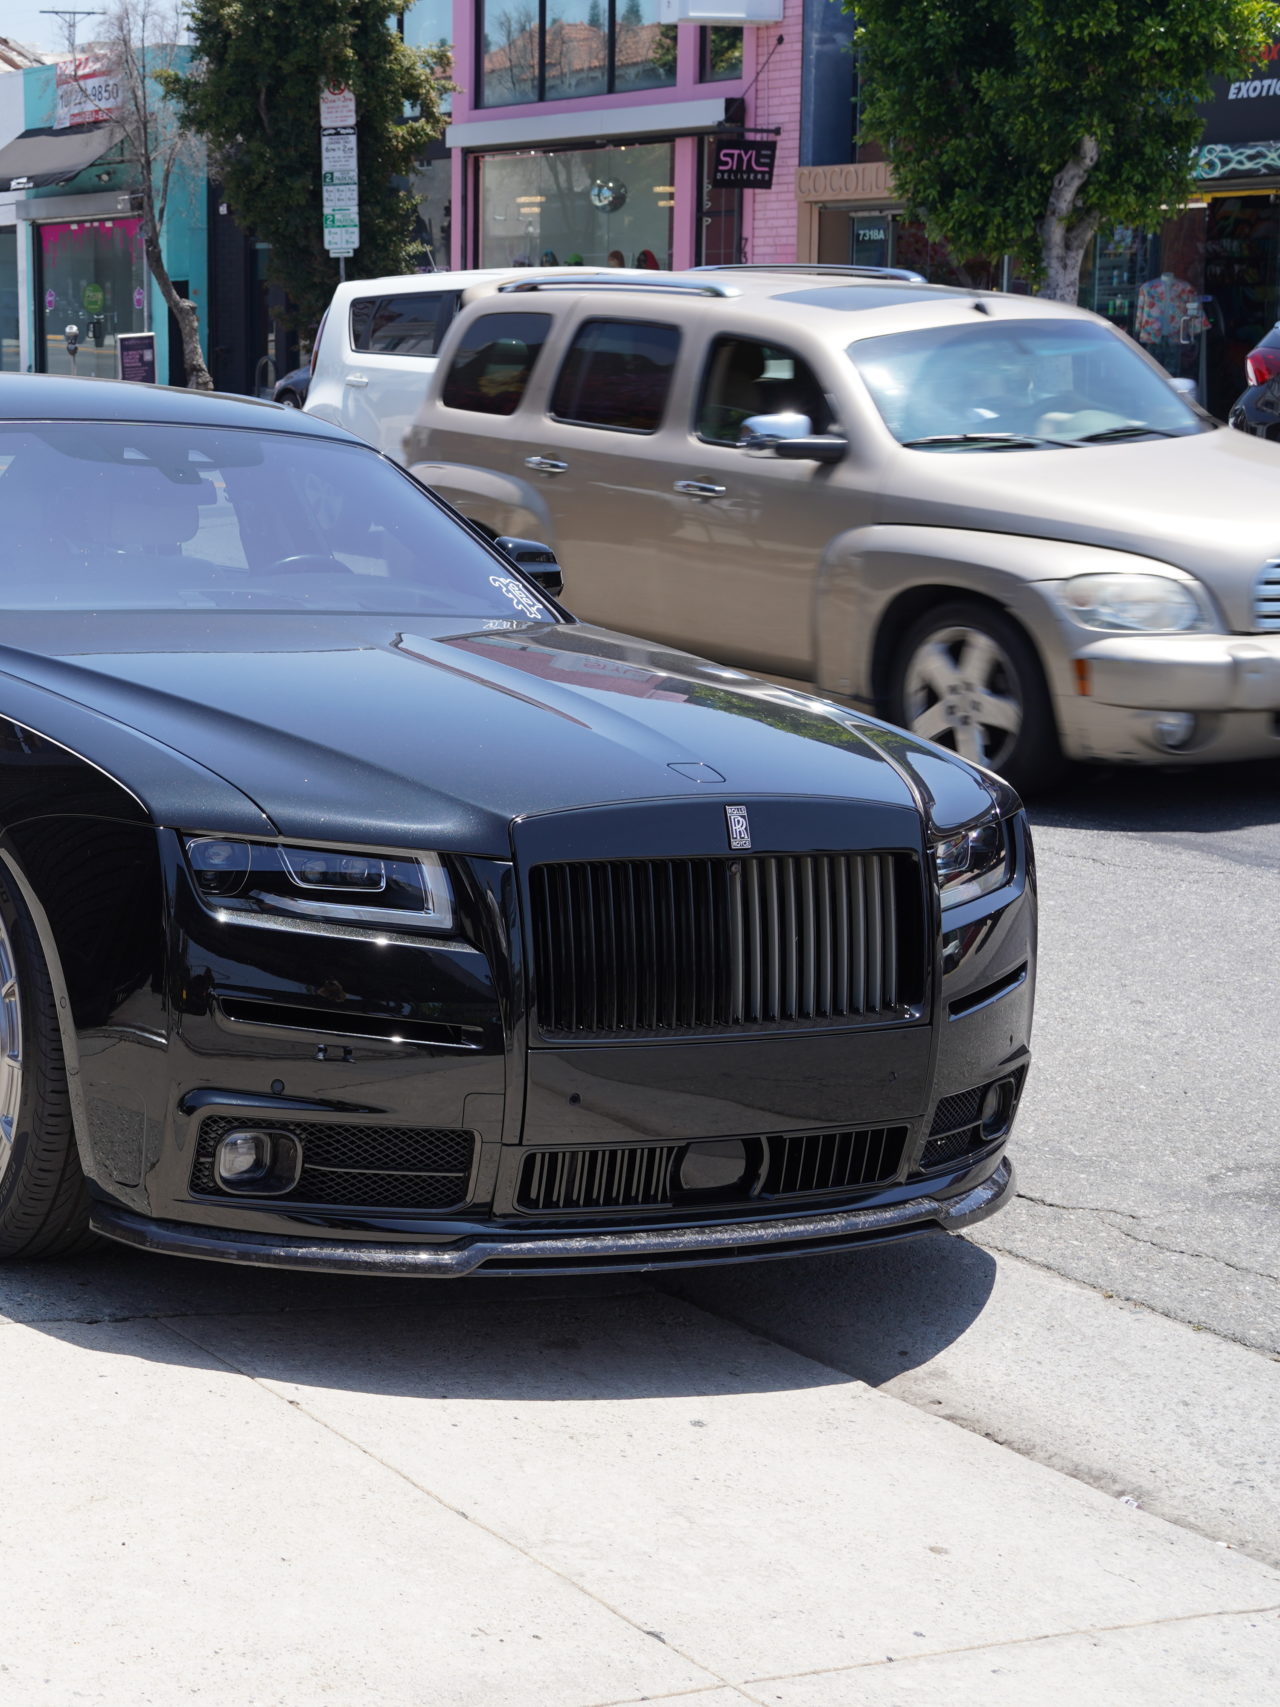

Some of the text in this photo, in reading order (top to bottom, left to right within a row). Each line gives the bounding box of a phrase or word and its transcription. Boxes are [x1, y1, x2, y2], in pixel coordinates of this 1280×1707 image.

[718, 149, 771, 171] STYLE
[325, 173, 332, 182] 2
[716, 172, 770, 180] DELIVERS
[326, 215, 333, 224] 2
[859, 229, 885, 241] 7318A
